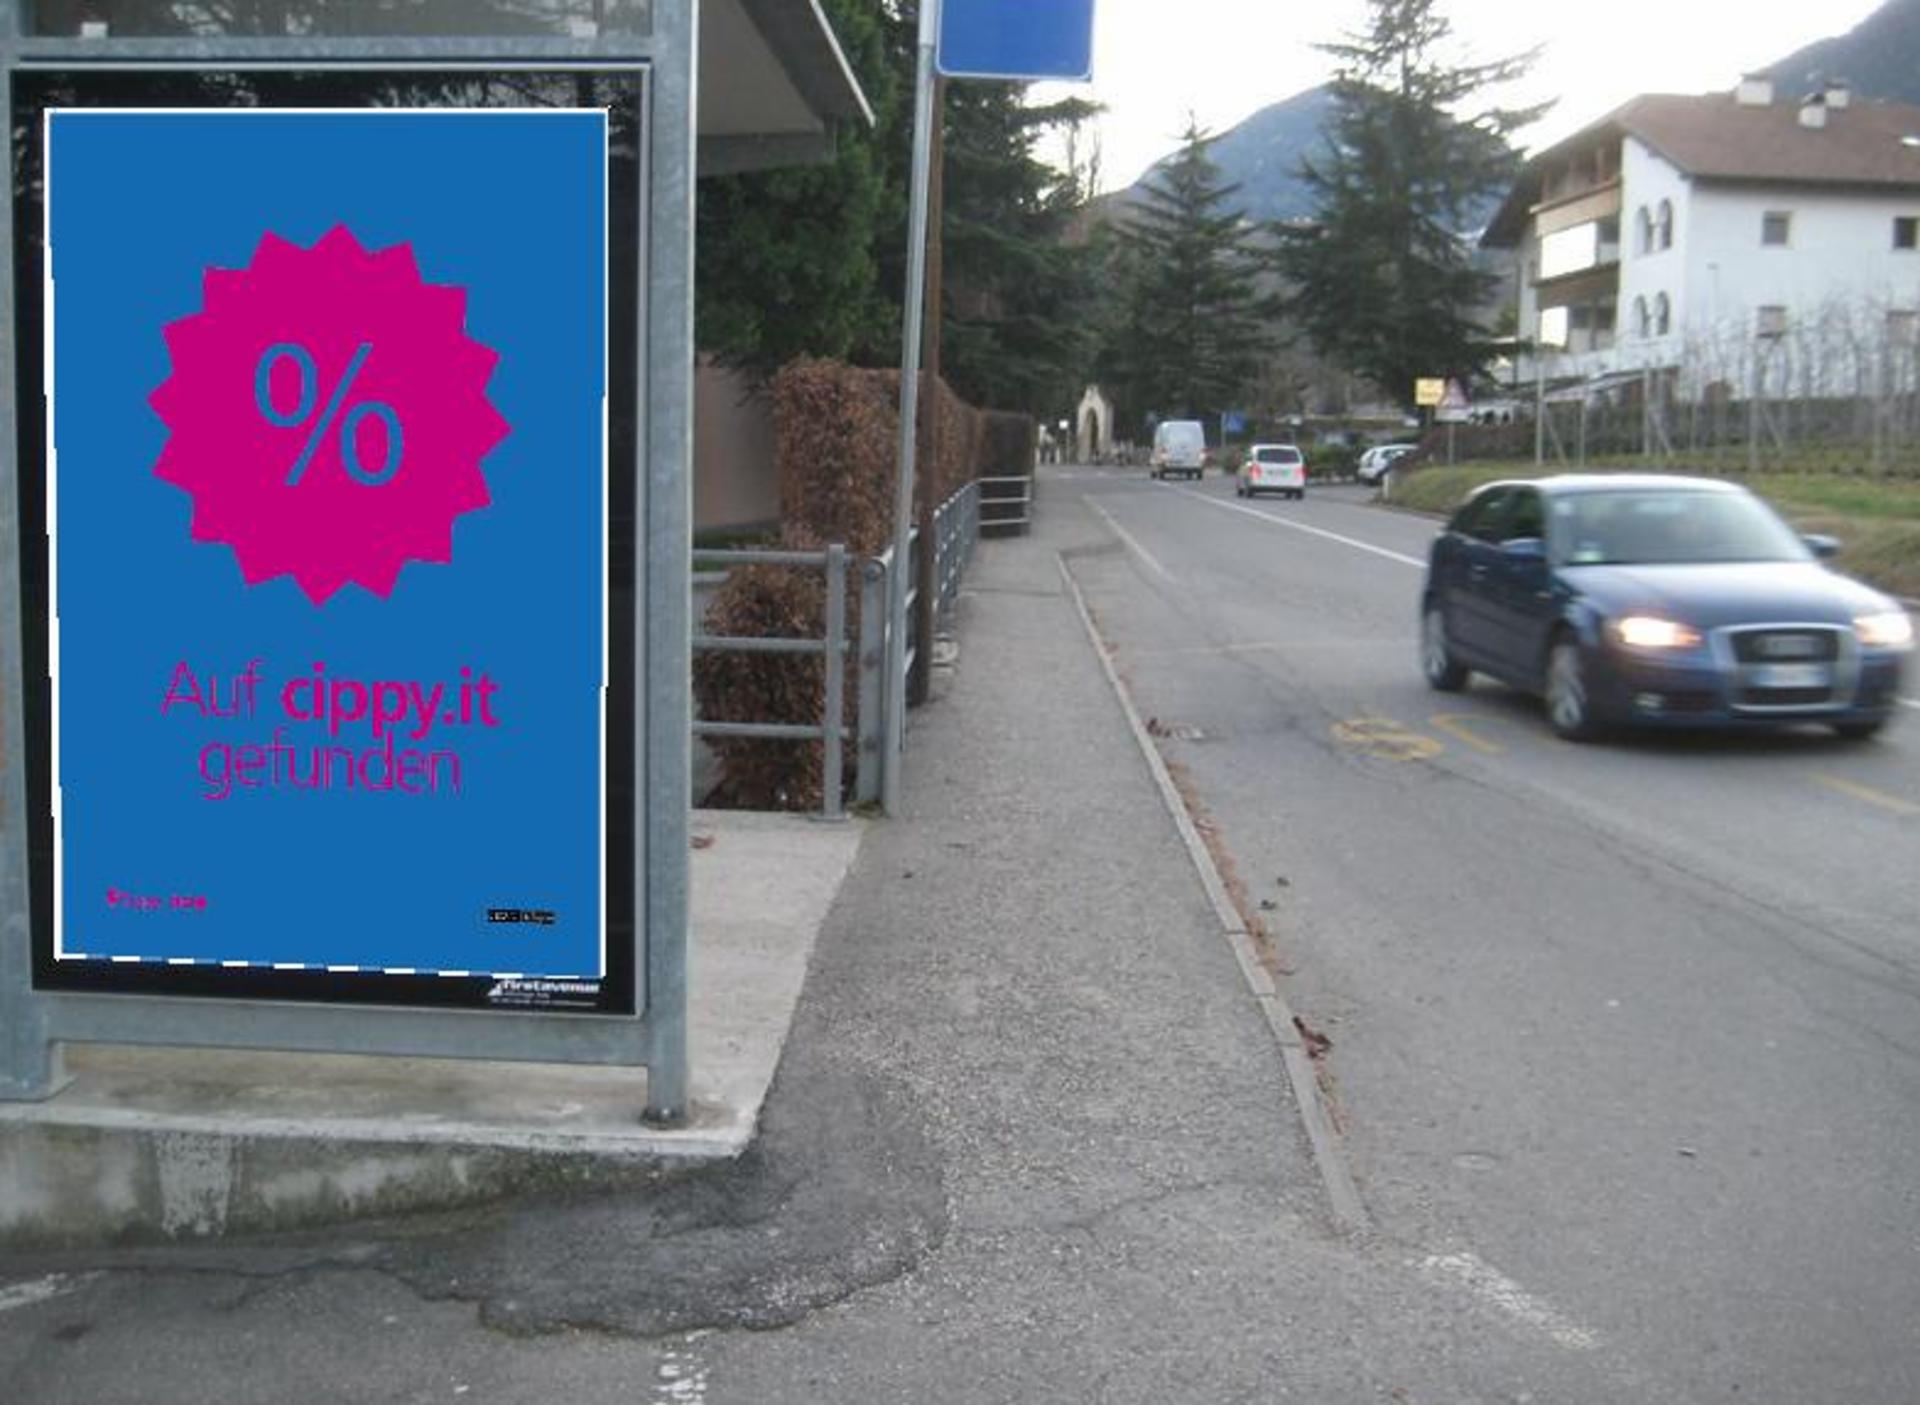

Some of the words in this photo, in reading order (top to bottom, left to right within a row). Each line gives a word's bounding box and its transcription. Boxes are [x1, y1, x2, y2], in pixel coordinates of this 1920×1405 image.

[254, 342, 404, 486] %
[161, 657, 263, 718] Auf
[281, 661, 500, 740] cippy.it
[199, 725, 463, 800] gefunden
